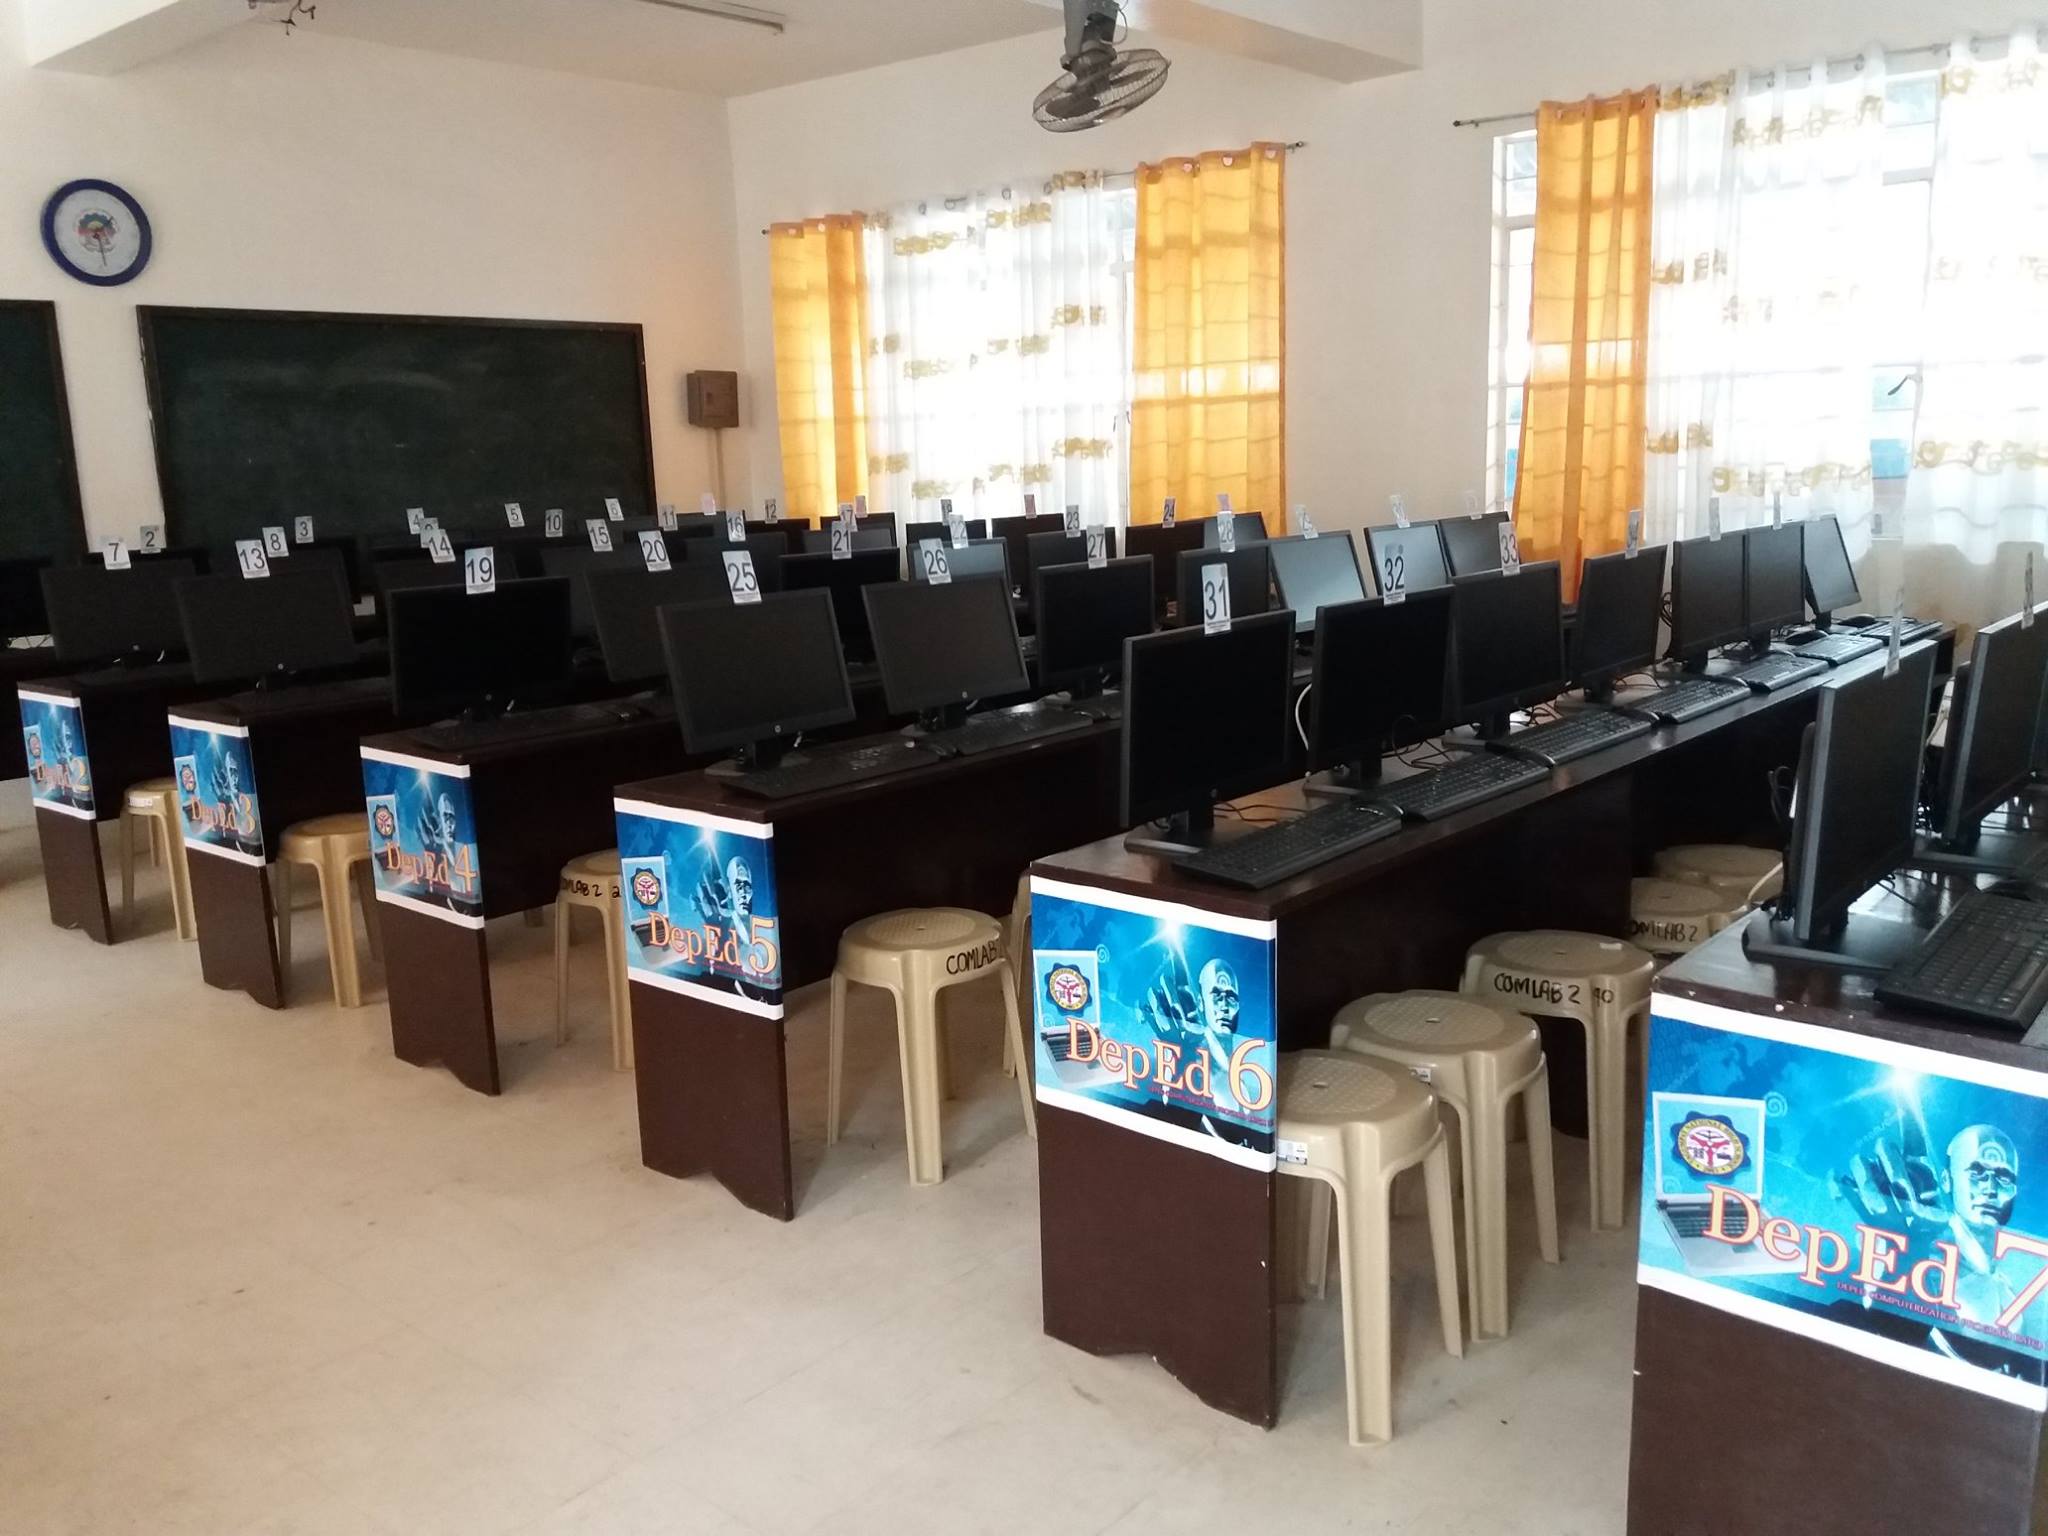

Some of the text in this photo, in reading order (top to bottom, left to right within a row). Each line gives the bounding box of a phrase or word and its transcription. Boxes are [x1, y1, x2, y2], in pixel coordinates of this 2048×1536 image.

[412, 513, 421, 529] 4
[511, 508, 519, 522] 5
[611, 503, 619, 516] 6
[765, 503, 777, 520] 12
[1066, 511, 1080, 531] 23
[1163, 504, 1175, 522] 24
[300, 521, 309, 538] 3
[546, 514, 561, 532] 10
[727, 516, 744, 535] 16
[950, 520, 967, 540] 22
[1218, 521, 1234, 544] 28
[145, 531, 155, 548] 2
[270, 533, 283, 552] 8
[428, 535, 451, 556] 14
[590, 526, 610, 546] 15
[832, 529, 850, 552] 21
[1087, 534, 1105, 559] 27
[107, 542, 121, 562] 7
[239, 547, 266, 571] 13
[642, 539, 667, 563] 20
[1500, 533, 1518, 565] 33
[465, 556, 493, 585] 19
[924, 549, 948, 576] 26
[1384, 555, 1405, 592] 32
[727, 562, 757, 592] 25
[1204, 578, 1228, 620] 31
[71, 757, 91, 793] 2
[238, 792, 256, 834] 3
[454, 843, 479, 896] 4
[592, 884, 602, 898] 2
[648, 911, 745, 967] DepEd
[749, 916, 778, 974] 5
[1689, 924, 1698, 942] 2
[946, 940, 997, 975] COMLAB
[1494, 973, 1563, 1004] COMLAB
[1567, 984, 1581, 1005] 2
[1066, 1016, 1215, 1101] DepEd
[1228, 1038, 1274, 1111] 6
[1702, 1183, 2048, 1330] DepEd 7
